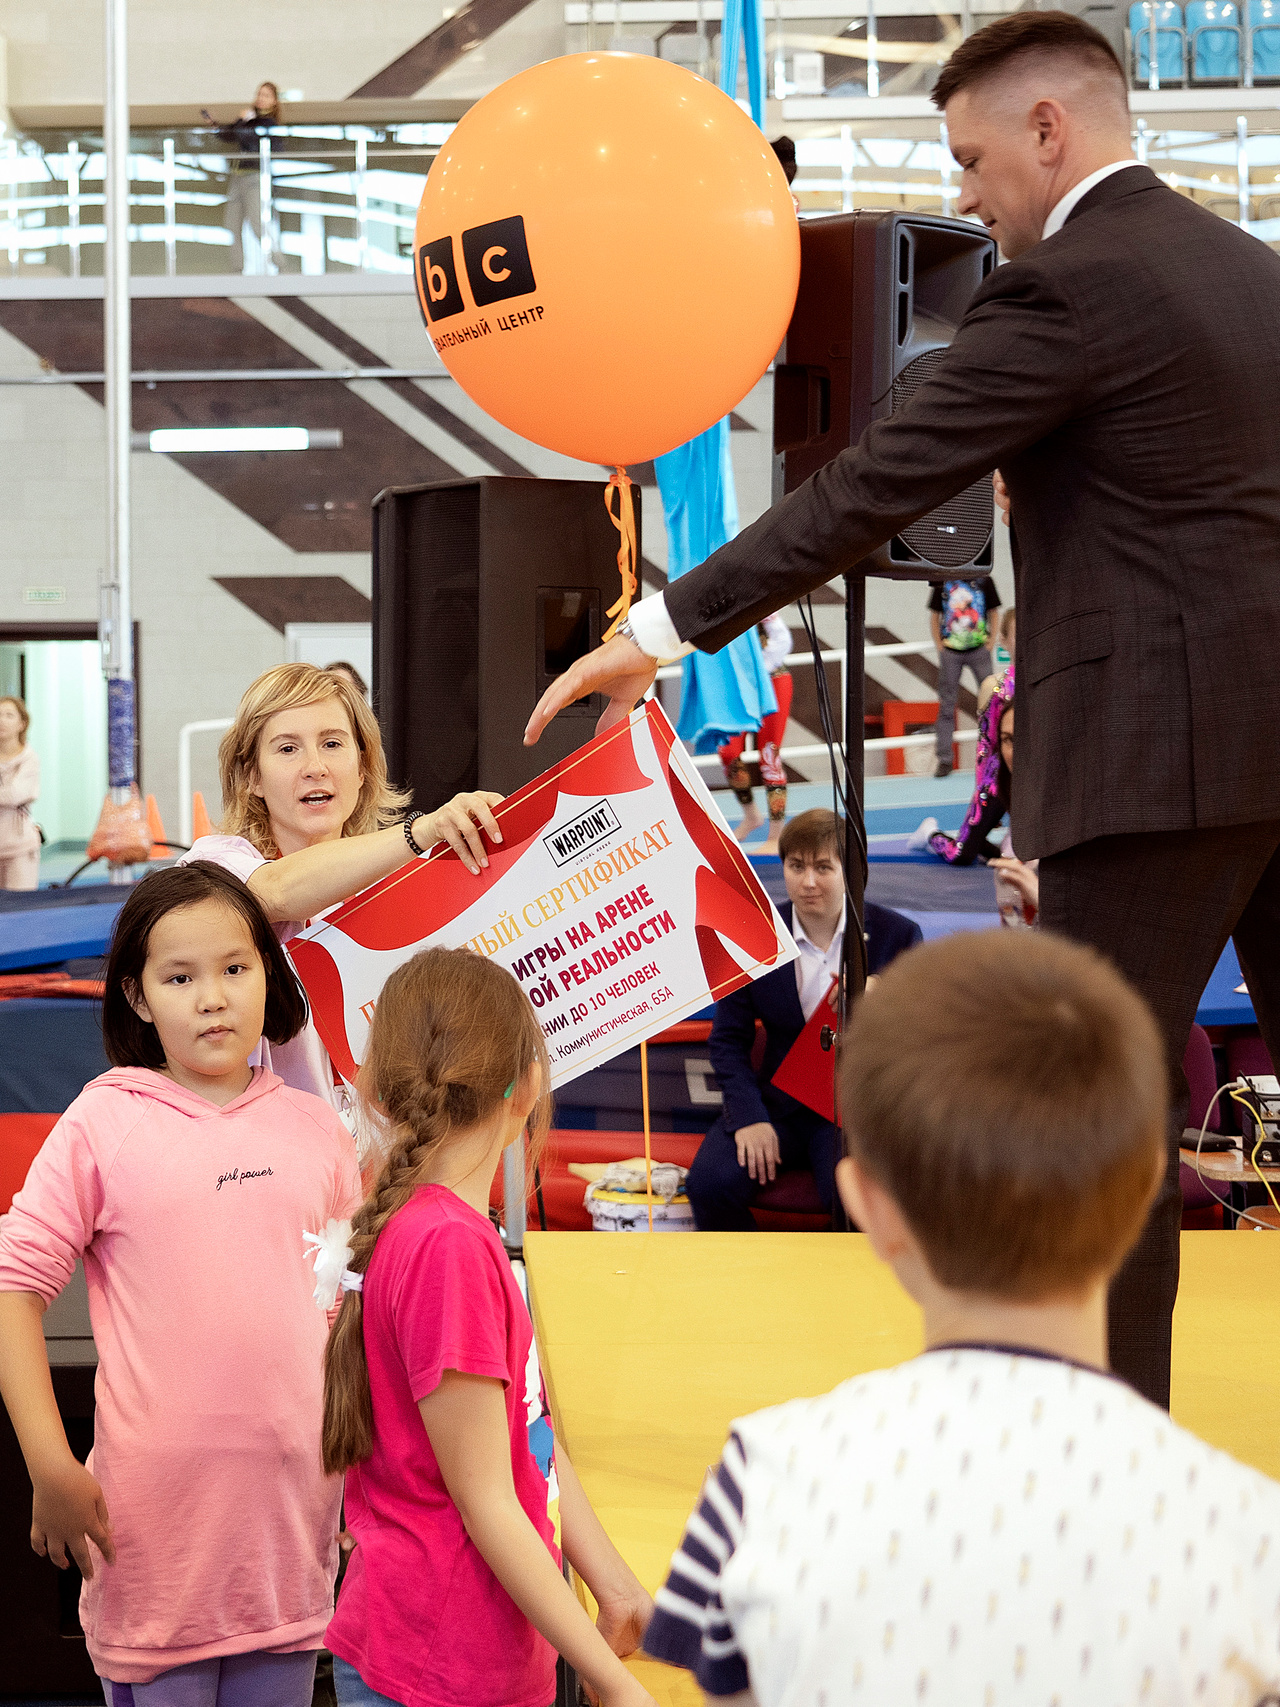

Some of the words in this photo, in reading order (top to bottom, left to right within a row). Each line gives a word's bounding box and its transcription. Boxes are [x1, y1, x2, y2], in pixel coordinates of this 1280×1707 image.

[497, 306, 544, 331] ЦЕНТР
[552, 808, 612, 857] WARPOINT
[522, 819, 673, 928] СЕРТИФИКАТ
[511, 937, 567, 981] ИГРЫ
[564, 921, 596, 950] НА
[595, 884, 654, 933] АРЕНЕ
[529, 973, 560, 1008] ОЙ
[558, 910, 677, 991] РЕАЛЬНОСТИ
[541, 1013, 570, 1039] НИИ
[570, 1003, 589, 1025] ДО
[589, 992, 607, 1011] 10
[605, 961, 662, 999] ЧЕЛОВЕК
[555, 1000, 653, 1058] Коммунистическая,
[651, 986, 675, 1006] 65А
[216, 1167, 239, 1191] girl
[239, 1166, 274, 1185] power
